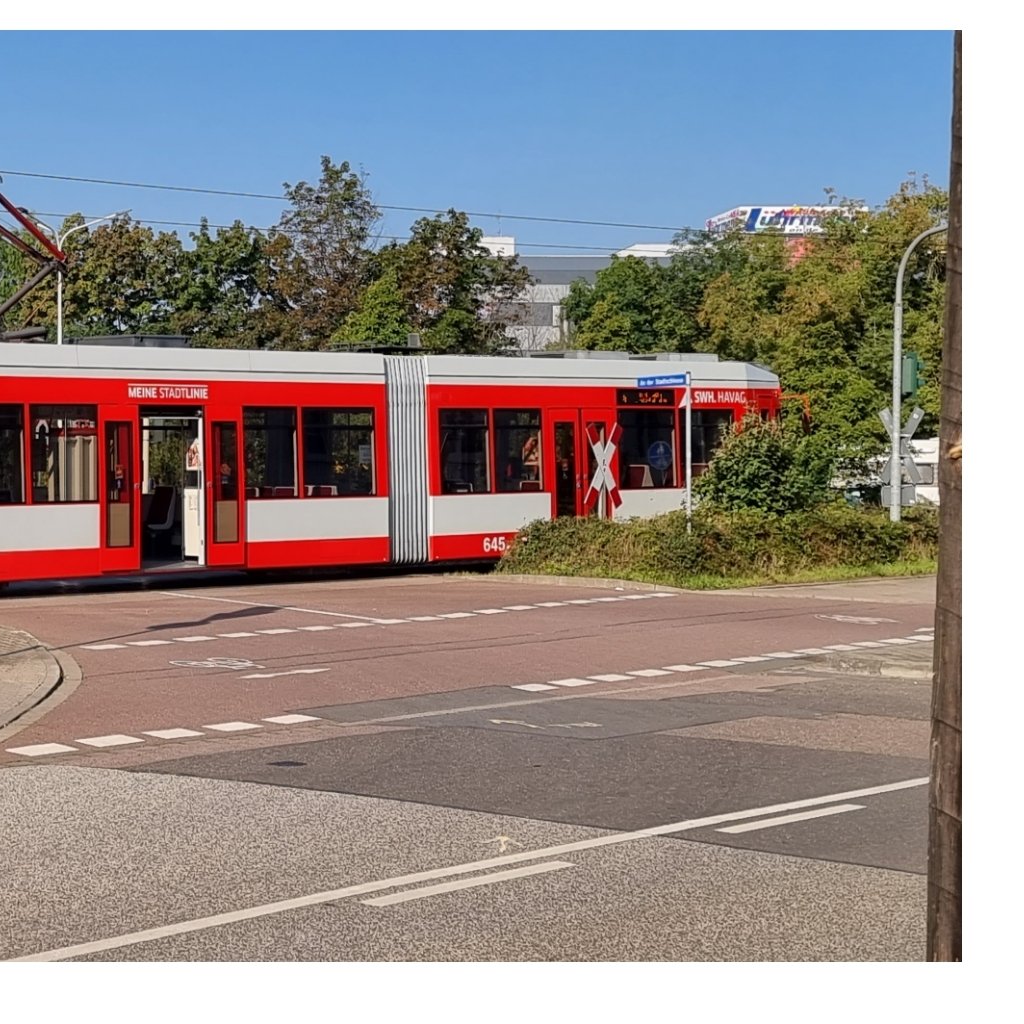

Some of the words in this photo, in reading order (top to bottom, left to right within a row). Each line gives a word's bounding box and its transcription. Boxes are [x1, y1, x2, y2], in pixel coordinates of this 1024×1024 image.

[128, 386, 157, 399] MEINE
[159, 386, 208, 400] STADTLINIE
[694, 390, 716, 404] SWH.
[717, 390, 746, 404] HAVAG
[483, 536, 506, 553] 645
